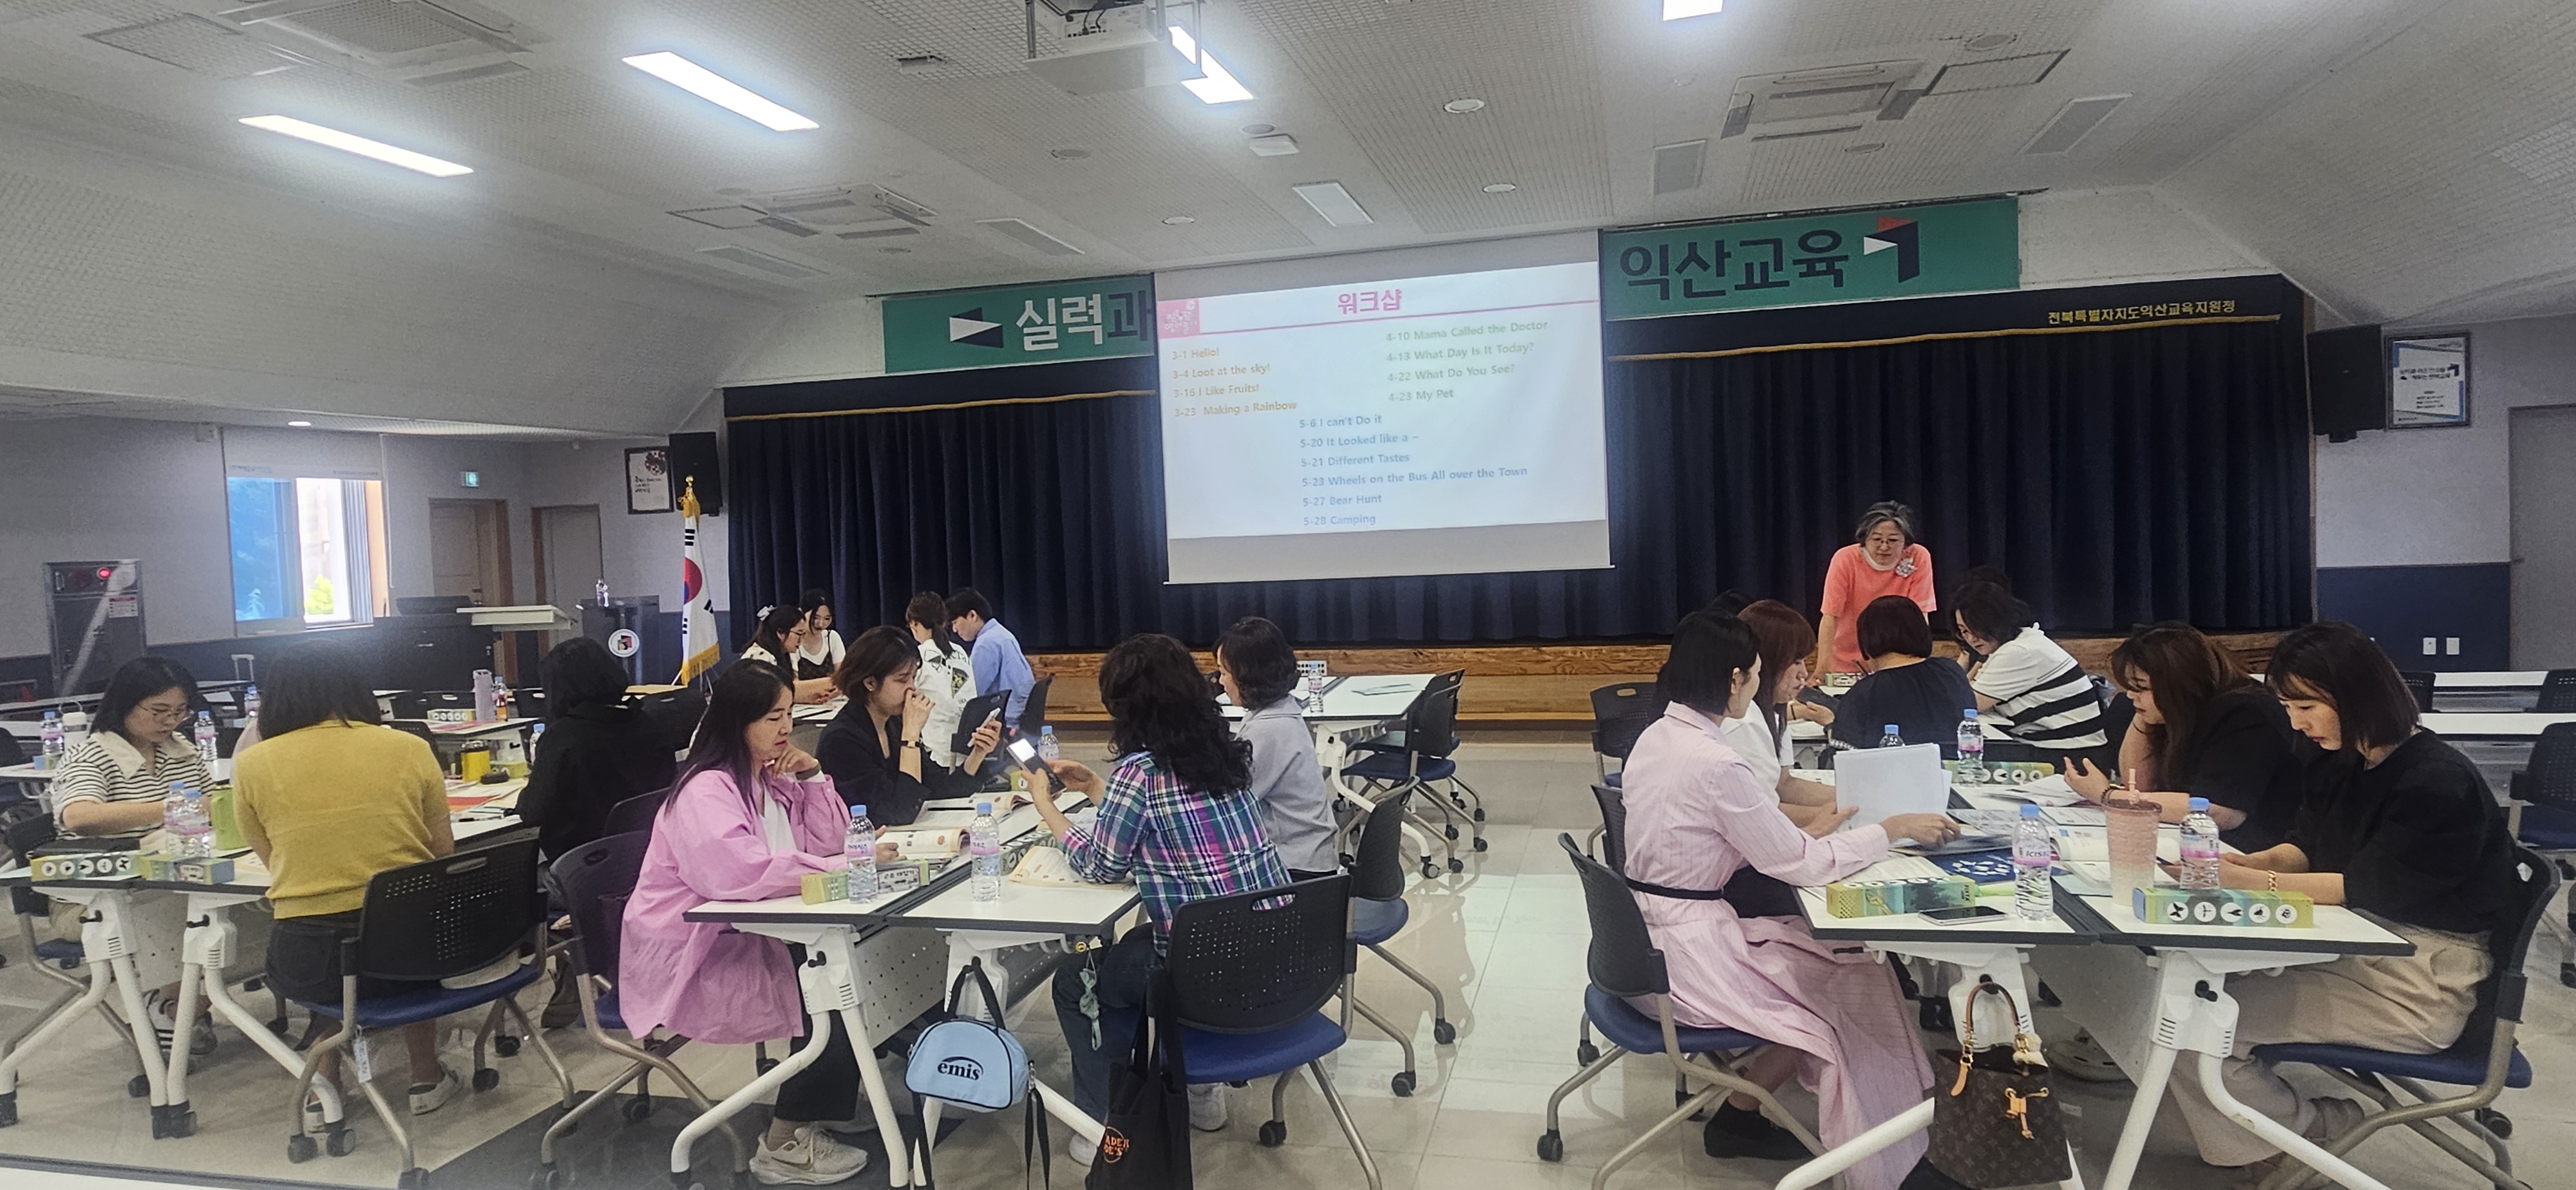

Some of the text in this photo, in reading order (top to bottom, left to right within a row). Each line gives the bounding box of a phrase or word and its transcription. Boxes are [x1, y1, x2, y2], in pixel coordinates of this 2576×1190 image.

[1620, 229, 1849, 300] 익산교육
[1338, 289, 1403, 314] 워크샵
[1016, 290, 1153, 351] 실력과
[1386, 321, 1548, 342] 4-10 Mama Called the Doctor
[1172, 348, 1220, 359] 3-1 Hello!
[1387, 343, 1534, 362] 4-13 What Day Is It Today?
[1173, 370, 1189, 379] 3-4
[1231, 366, 1247, 374] the
[1251, 363, 1271, 375] sky!
[1387, 364, 1515, 381] 4-22 What Do You See?
[1174, 388, 1195, 397] 3-16
[1206, 386, 1225, 395] Like
[1229, 384, 1259, 393] Fruits!
[1388, 389, 1454, 401] 4-23 My Pet
[1175, 408, 1196, 417] 3-23
[1204, 404, 1240, 415] Making
[1253, 401, 1297, 411] Rainbow
[1300, 419, 1316, 428] 5-6
[1327, 417, 1352, 426] can't
[1356, 416, 1370, 425] Do
[1374, 415, 1382, 424] it
[1300, 439, 1323, 448] 5-20
[1327, 438, 1335, 446] It
[1338, 435, 1376, 446] Looked
[1379, 433, 1398, 443] like
[1301, 453, 1410, 467] 5-21 Different Tastes
[1302, 477, 1324, 487] 5-23
[1329, 475, 1366, 486] Wheels
[1387, 473, 1404, 482] the
[1408, 472, 1427, 482] Bus
[1431, 470, 1445, 480] All
[1449, 471, 1473, 479] over
[1477, 468, 1495, 478] the
[1498, 467, 1528, 477] Town
[1303, 494, 1382, 507] 5-27 Bear Hunt
[1303, 515, 1376, 526] 5-28 Camping
[938, 1062, 980, 1081] emis
[1105, 1135, 1130, 1148] ADER
